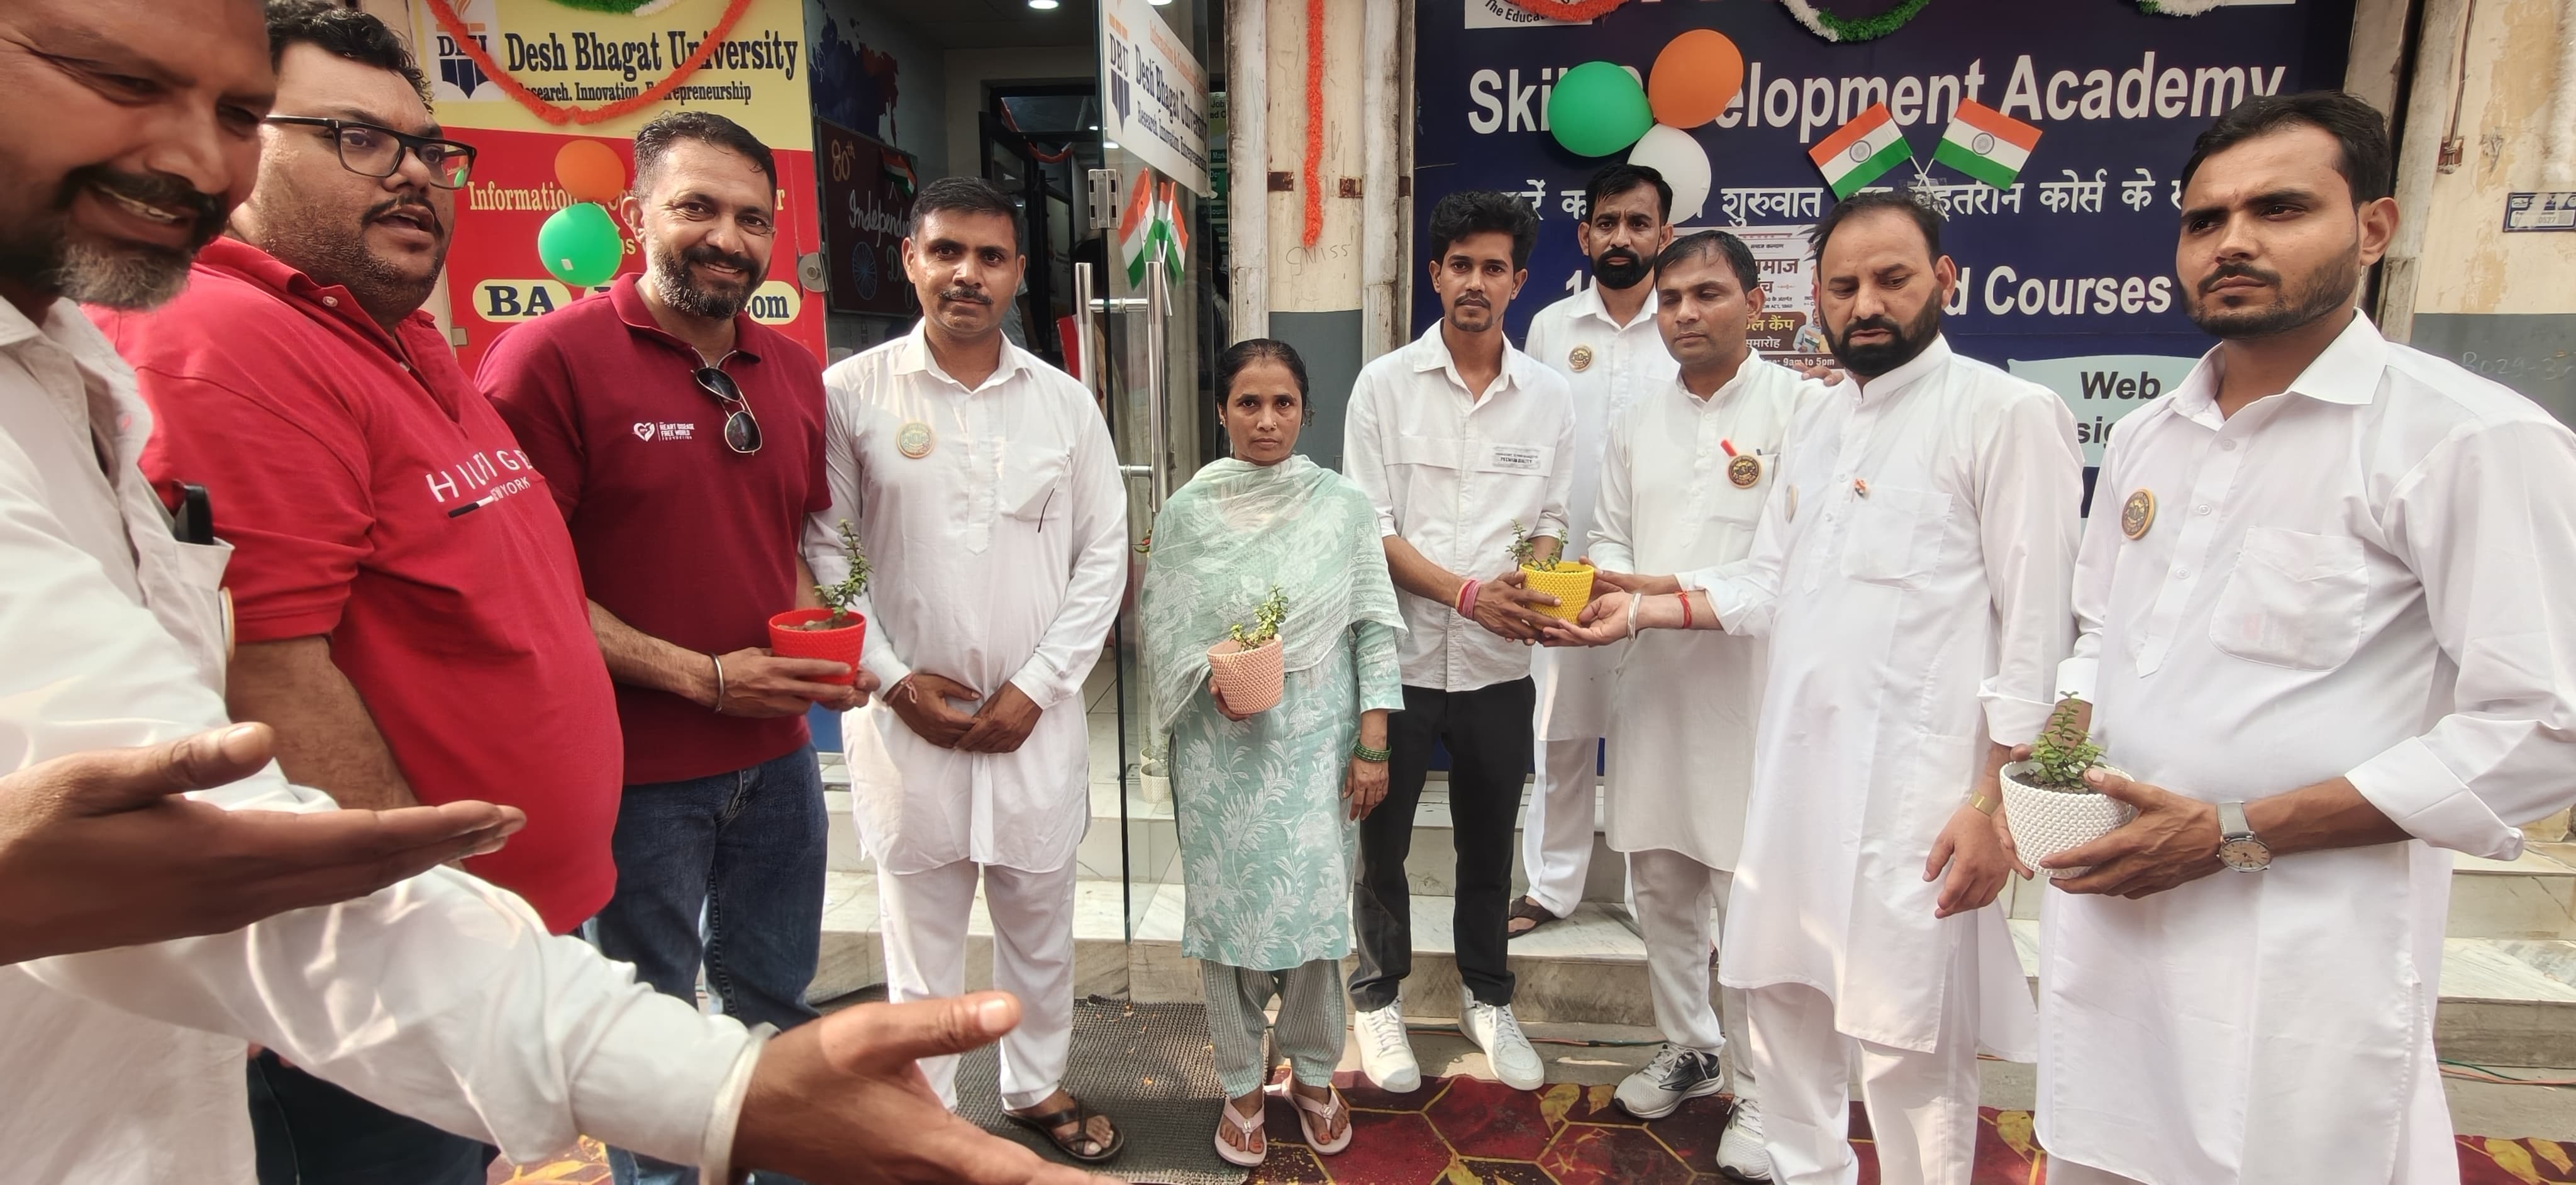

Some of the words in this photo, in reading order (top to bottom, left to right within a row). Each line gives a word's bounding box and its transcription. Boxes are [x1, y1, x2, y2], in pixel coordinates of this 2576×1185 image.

[505, 32, 569, 72] Desh
[572, 31, 662, 82] Bhagat
[1109, 32, 1128, 77] DBU
[1135, 43, 1155, 98] Desh
[1155, 65, 1180, 125] Bhagat
[1721, 187, 1824, 227] शुरुवात
[2040, 169, 2108, 213] कोर्स
[2121, 168, 2156, 212] के
[1984, 265, 2172, 316] Courses
[1805, 357, 1814, 366] to
[2080, 371, 2161, 400] Web
